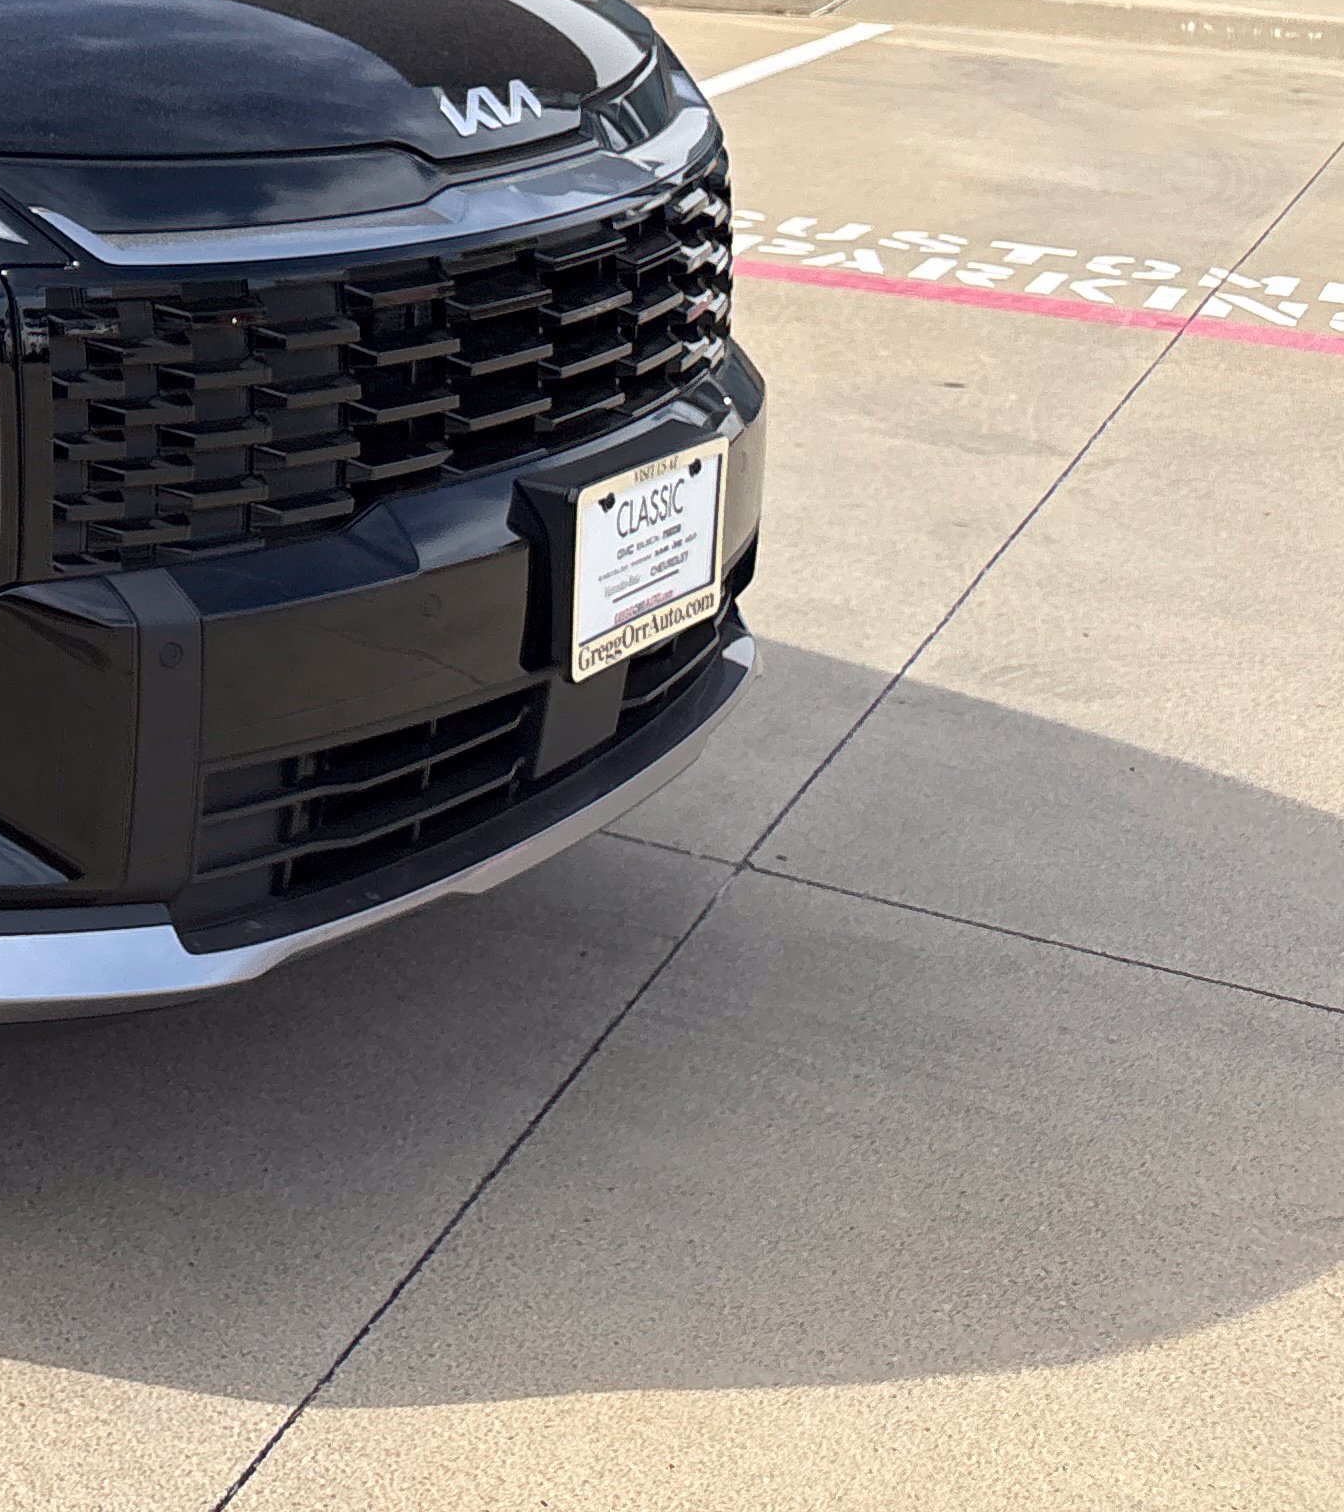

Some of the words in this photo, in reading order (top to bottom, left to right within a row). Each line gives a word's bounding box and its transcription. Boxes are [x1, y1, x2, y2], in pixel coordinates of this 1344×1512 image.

[438, 79, 542, 137] KIA
[732, 233, 1344, 334] PARKIN
[617, 478, 685, 538] CLASSIC
[578, 593, 714, 672] GreggOrrAuto.com
